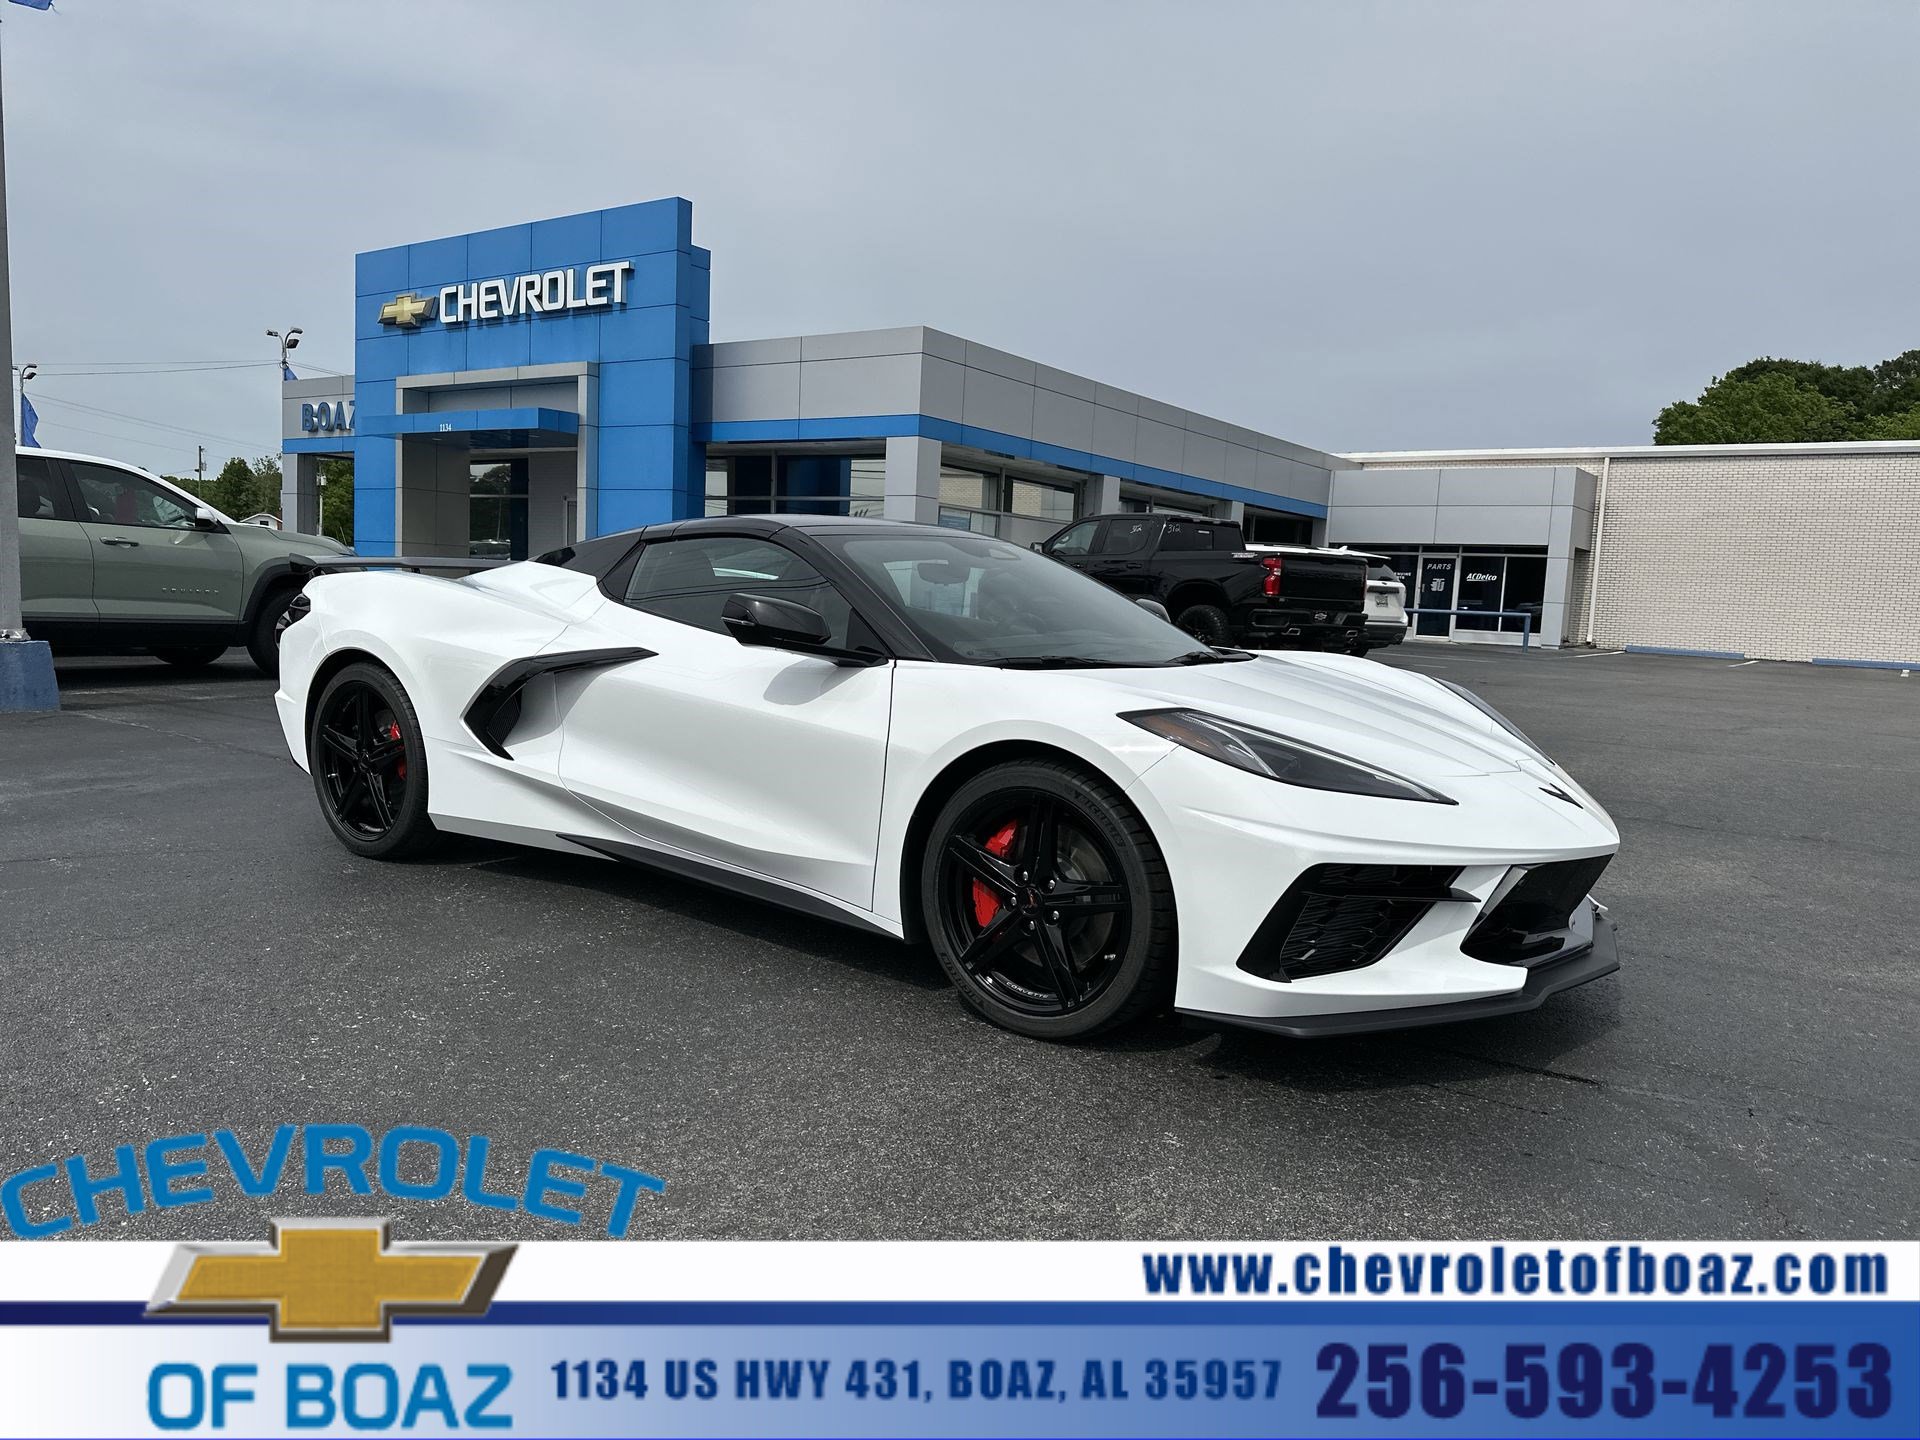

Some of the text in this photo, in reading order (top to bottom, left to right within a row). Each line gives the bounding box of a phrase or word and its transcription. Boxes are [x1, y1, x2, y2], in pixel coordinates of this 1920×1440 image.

[439, 261, 633, 324] CHEVROLET
[439, 423, 452, 432] 1134
[1466, 573, 1497, 581] ACDelco
